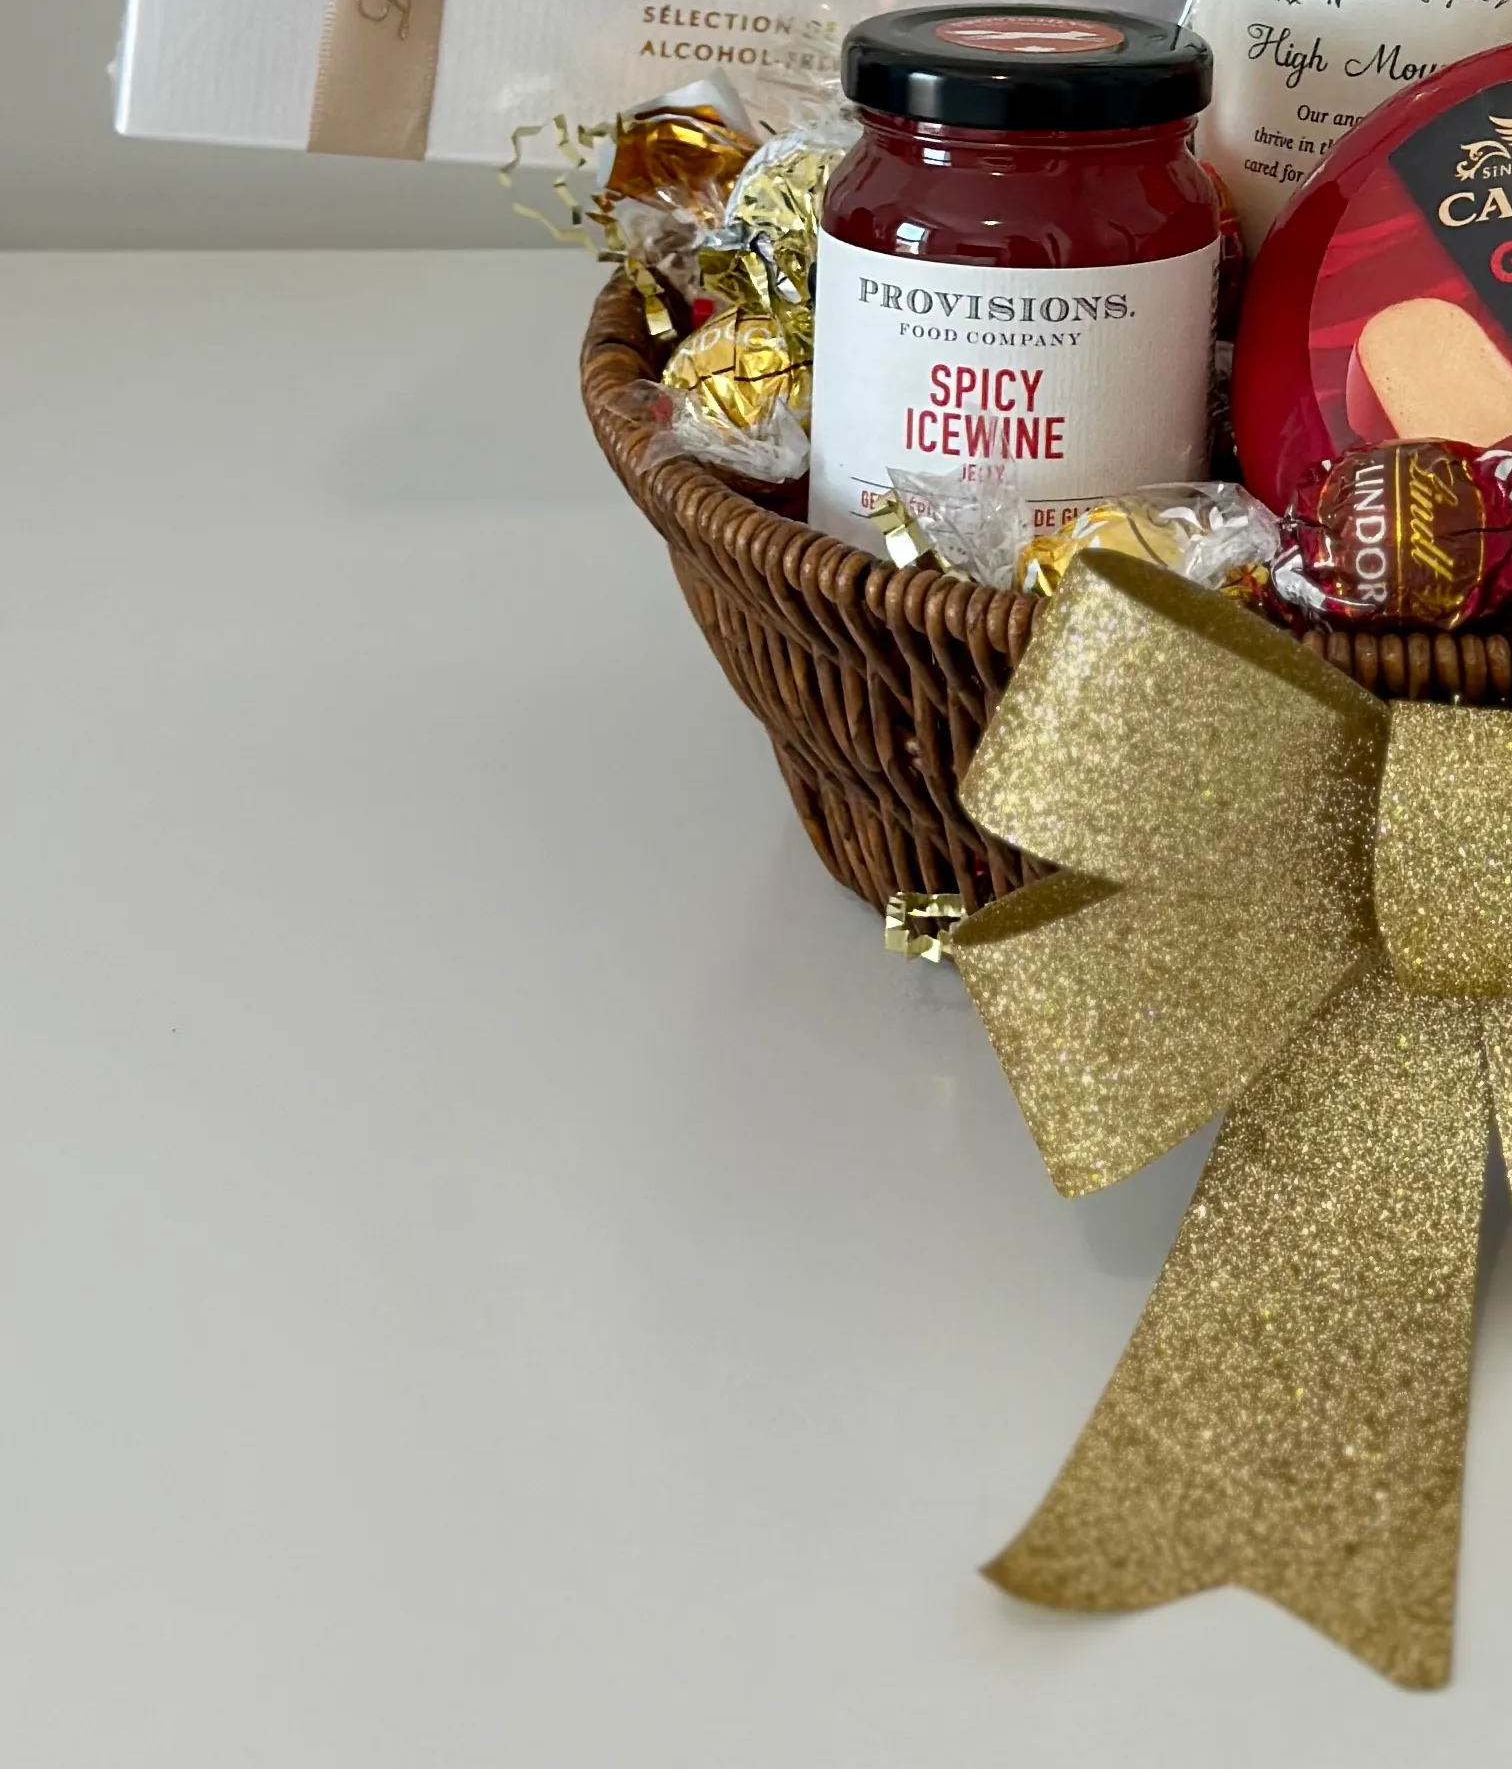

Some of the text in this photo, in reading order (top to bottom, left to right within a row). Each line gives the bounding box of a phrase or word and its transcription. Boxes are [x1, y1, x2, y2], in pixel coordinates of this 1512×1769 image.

[641, 4, 795, 35] SÉLECTION
[1246, 23, 1445, 89] High Mou
[1297, 104, 1329, 124] Our
[1254, 126, 1294, 150] thrive
[1298, 136, 1315, 154] in
[1244, 158, 1304, 184] cared for
[899, 322, 1082, 347] FOOD COMPANY
[929, 364, 1044, 413] SPICY
[905, 407, 1066, 461] ICEWINE
[1034, 507, 1056, 528] DE
[1353, 463, 1388, 604] LINDOR
